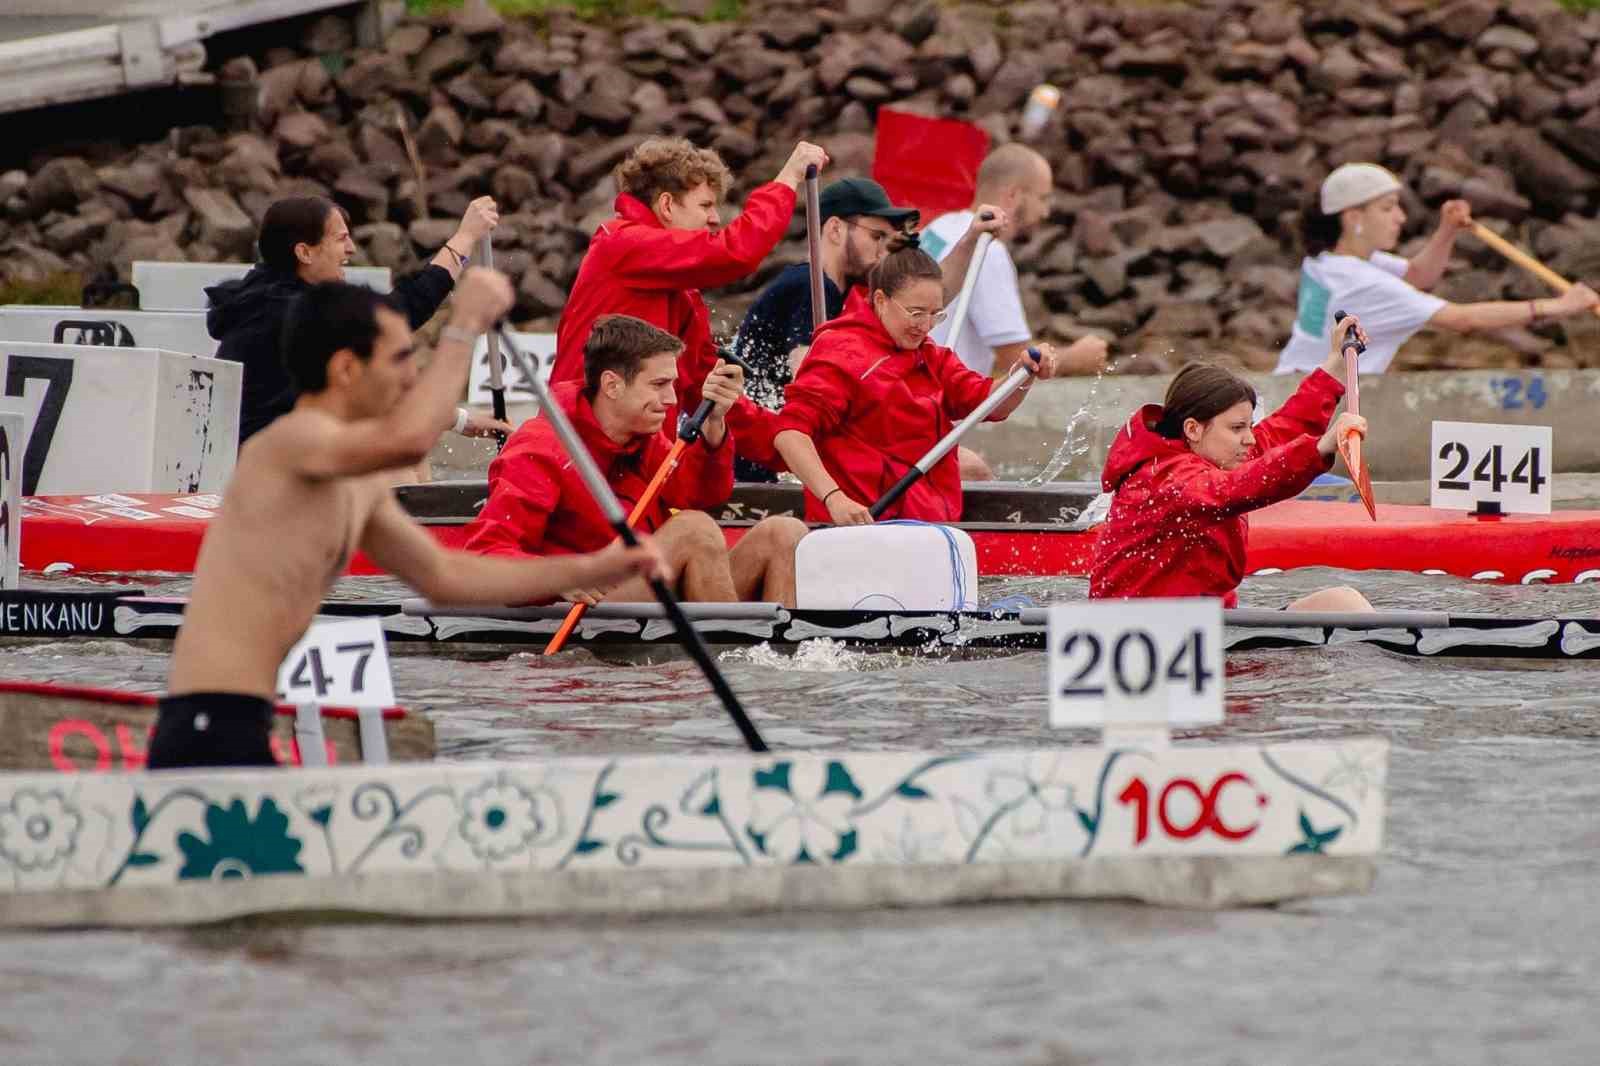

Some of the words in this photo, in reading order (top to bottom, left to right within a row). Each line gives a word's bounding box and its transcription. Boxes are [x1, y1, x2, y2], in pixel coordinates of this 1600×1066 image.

[478, 351, 556, 393] 22
[5, 355, 75, 497] 7
[1438, 441, 1546, 494] 244
[1062, 630, 1213, 695] 204
